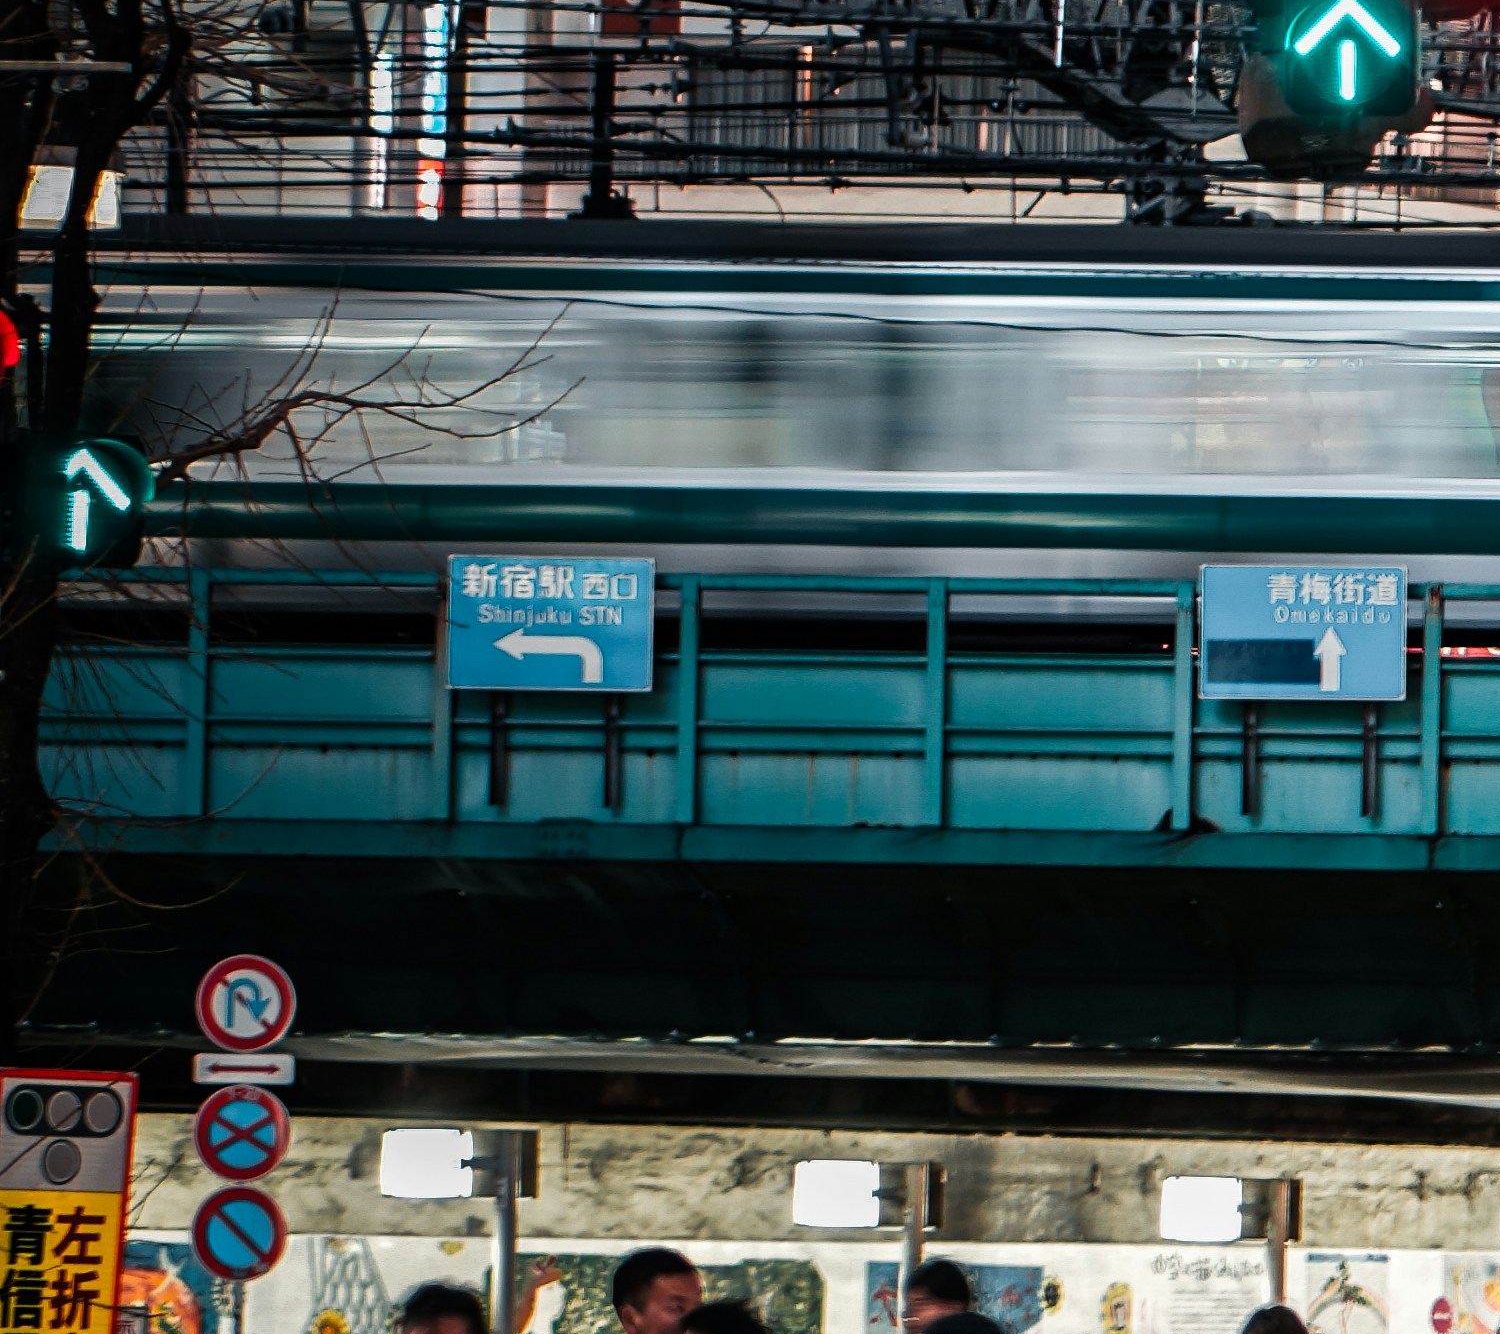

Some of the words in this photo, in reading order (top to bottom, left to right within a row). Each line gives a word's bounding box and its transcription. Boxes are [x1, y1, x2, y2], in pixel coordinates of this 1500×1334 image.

[1266, 571, 1399, 606] 青梅街道
[477, 603, 573, 626] Shinjuku
[578, 605, 623, 626] STN
